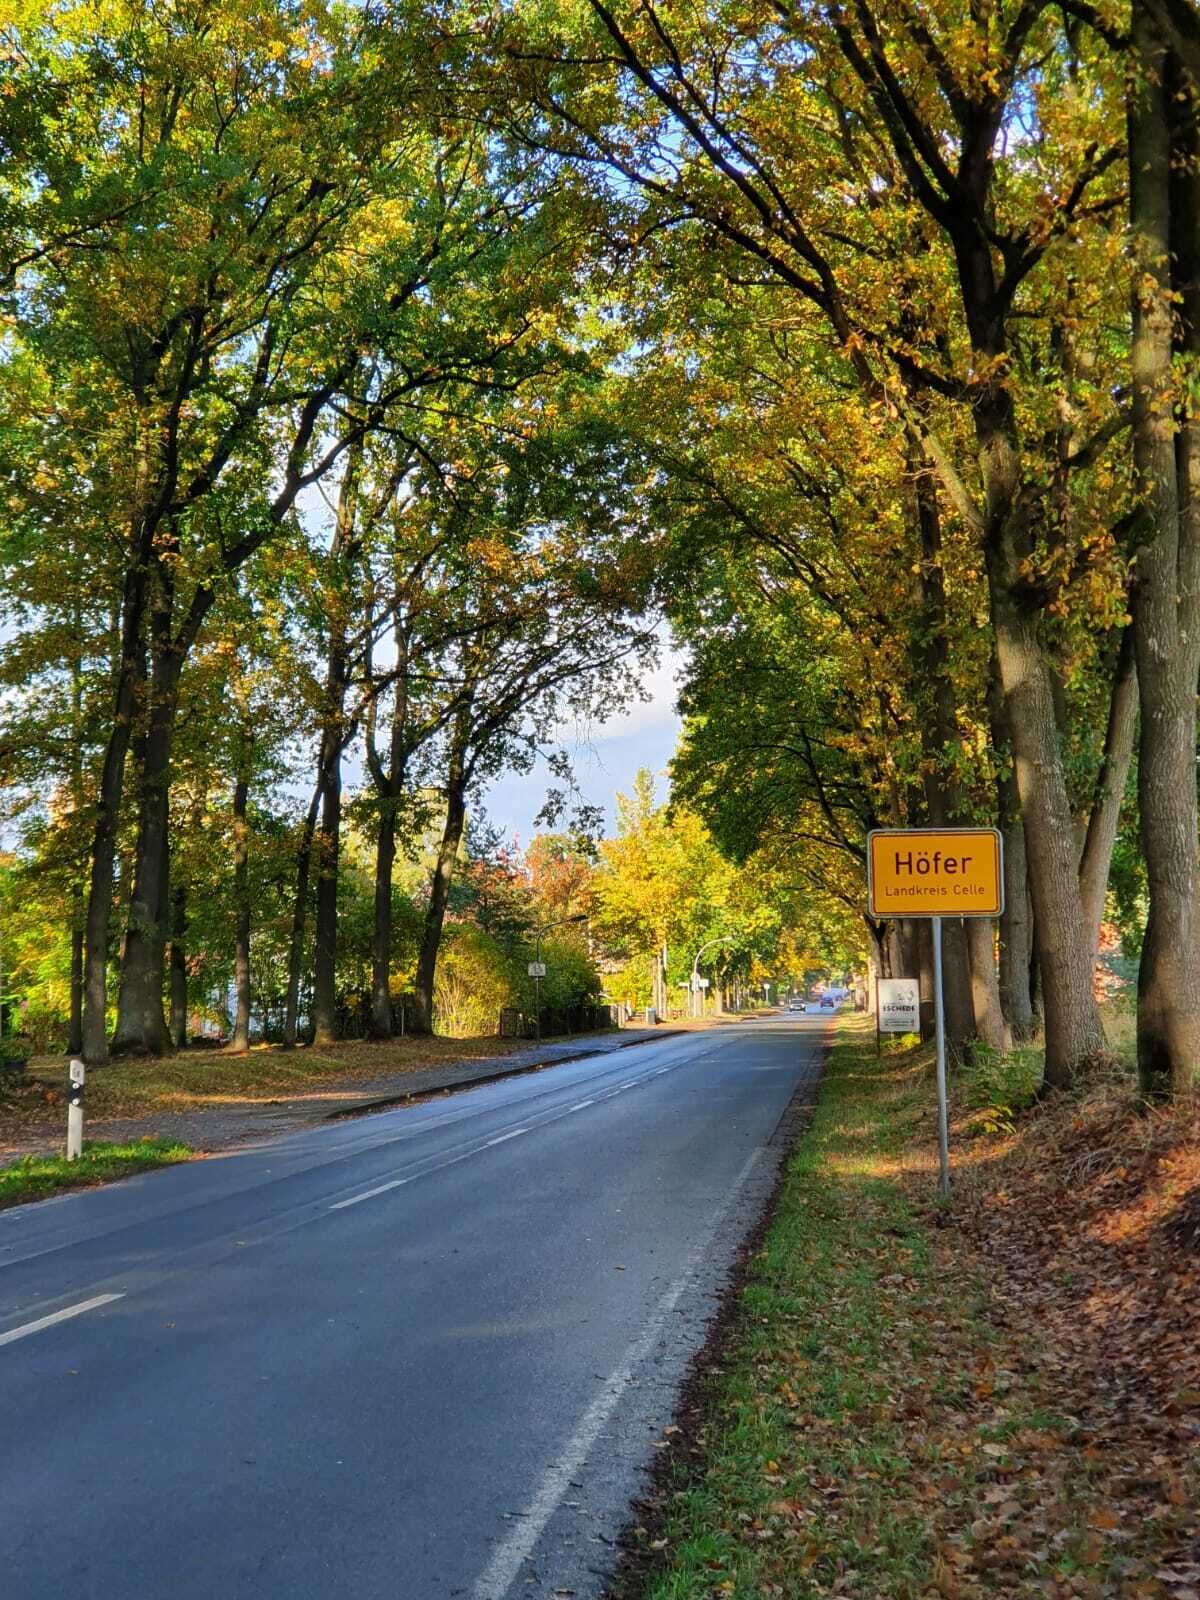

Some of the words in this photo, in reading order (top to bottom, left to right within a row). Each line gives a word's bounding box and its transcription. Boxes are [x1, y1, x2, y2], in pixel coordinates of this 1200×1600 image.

[895, 850, 973, 875] Höfer
[885, 885, 948, 897] Landkreis
[953, 884, 985, 896] Celle
